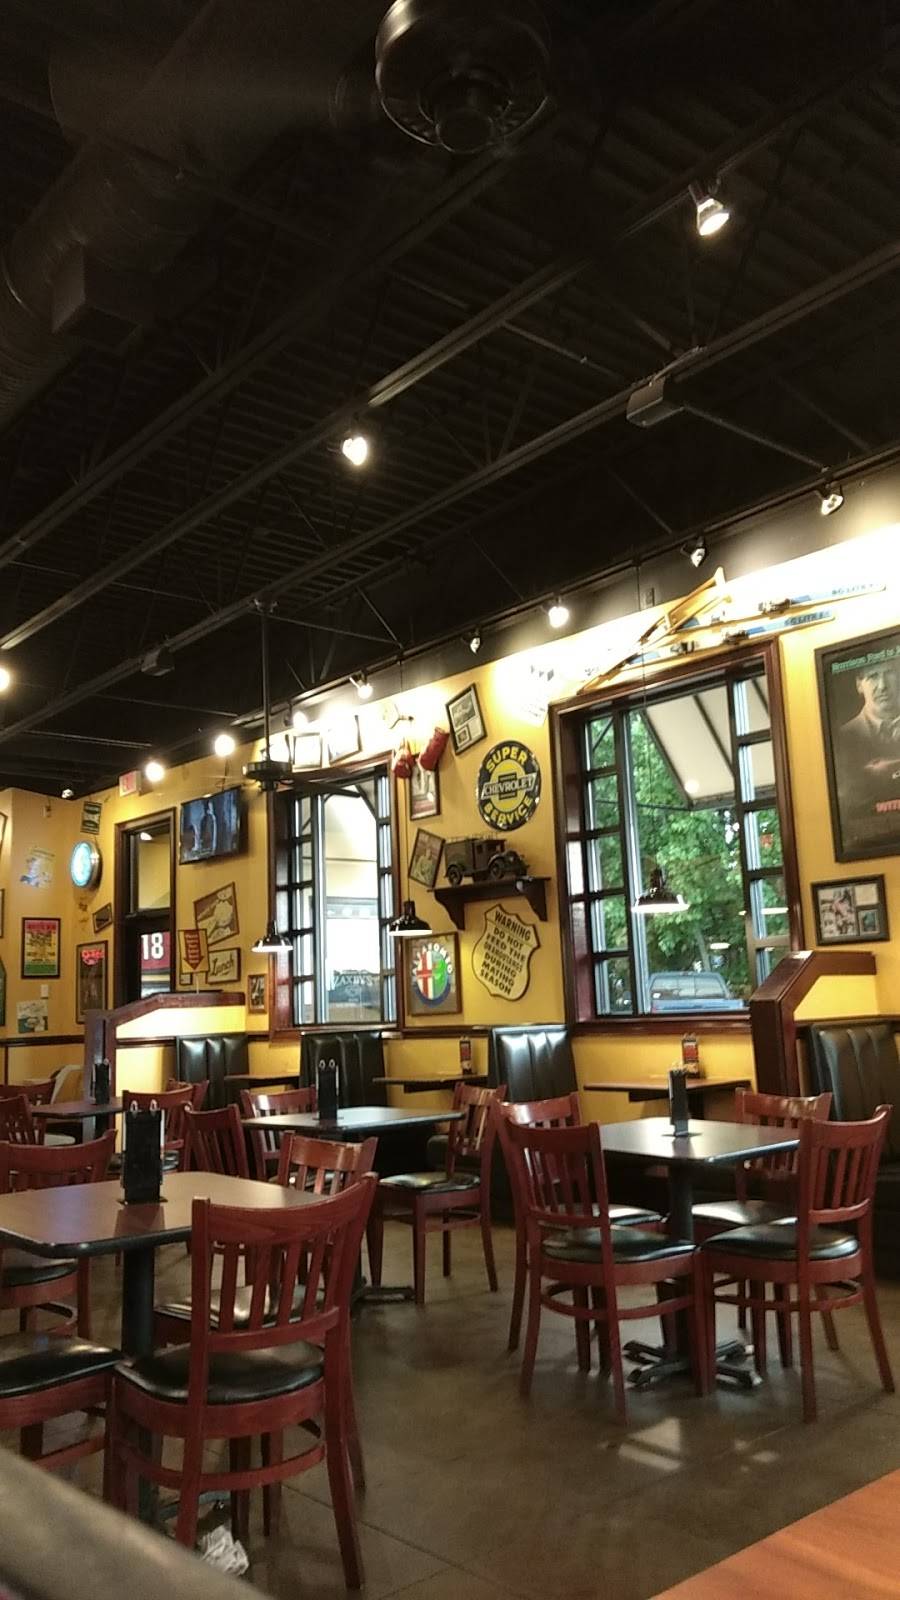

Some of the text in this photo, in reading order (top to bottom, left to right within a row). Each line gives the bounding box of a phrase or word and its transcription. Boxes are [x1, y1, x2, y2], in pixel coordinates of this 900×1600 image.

[486, 746, 528, 772] SUPER
[484, 776, 534, 795] CHEVROLET
[483, 795, 533, 825] SERVICE
[494, 927, 524, 950] DO NOT
[495, 910, 531, 941] WARNING
[141, 932, 164, 960] 18
[486, 933, 507, 950] FEED
[509, 946, 526, 962] THE
[210, 953, 234, 977] Lunch
[481, 960, 515, 987] MATING
[485, 952, 517, 978] DURING
[480, 968, 512, 995] SEASON
